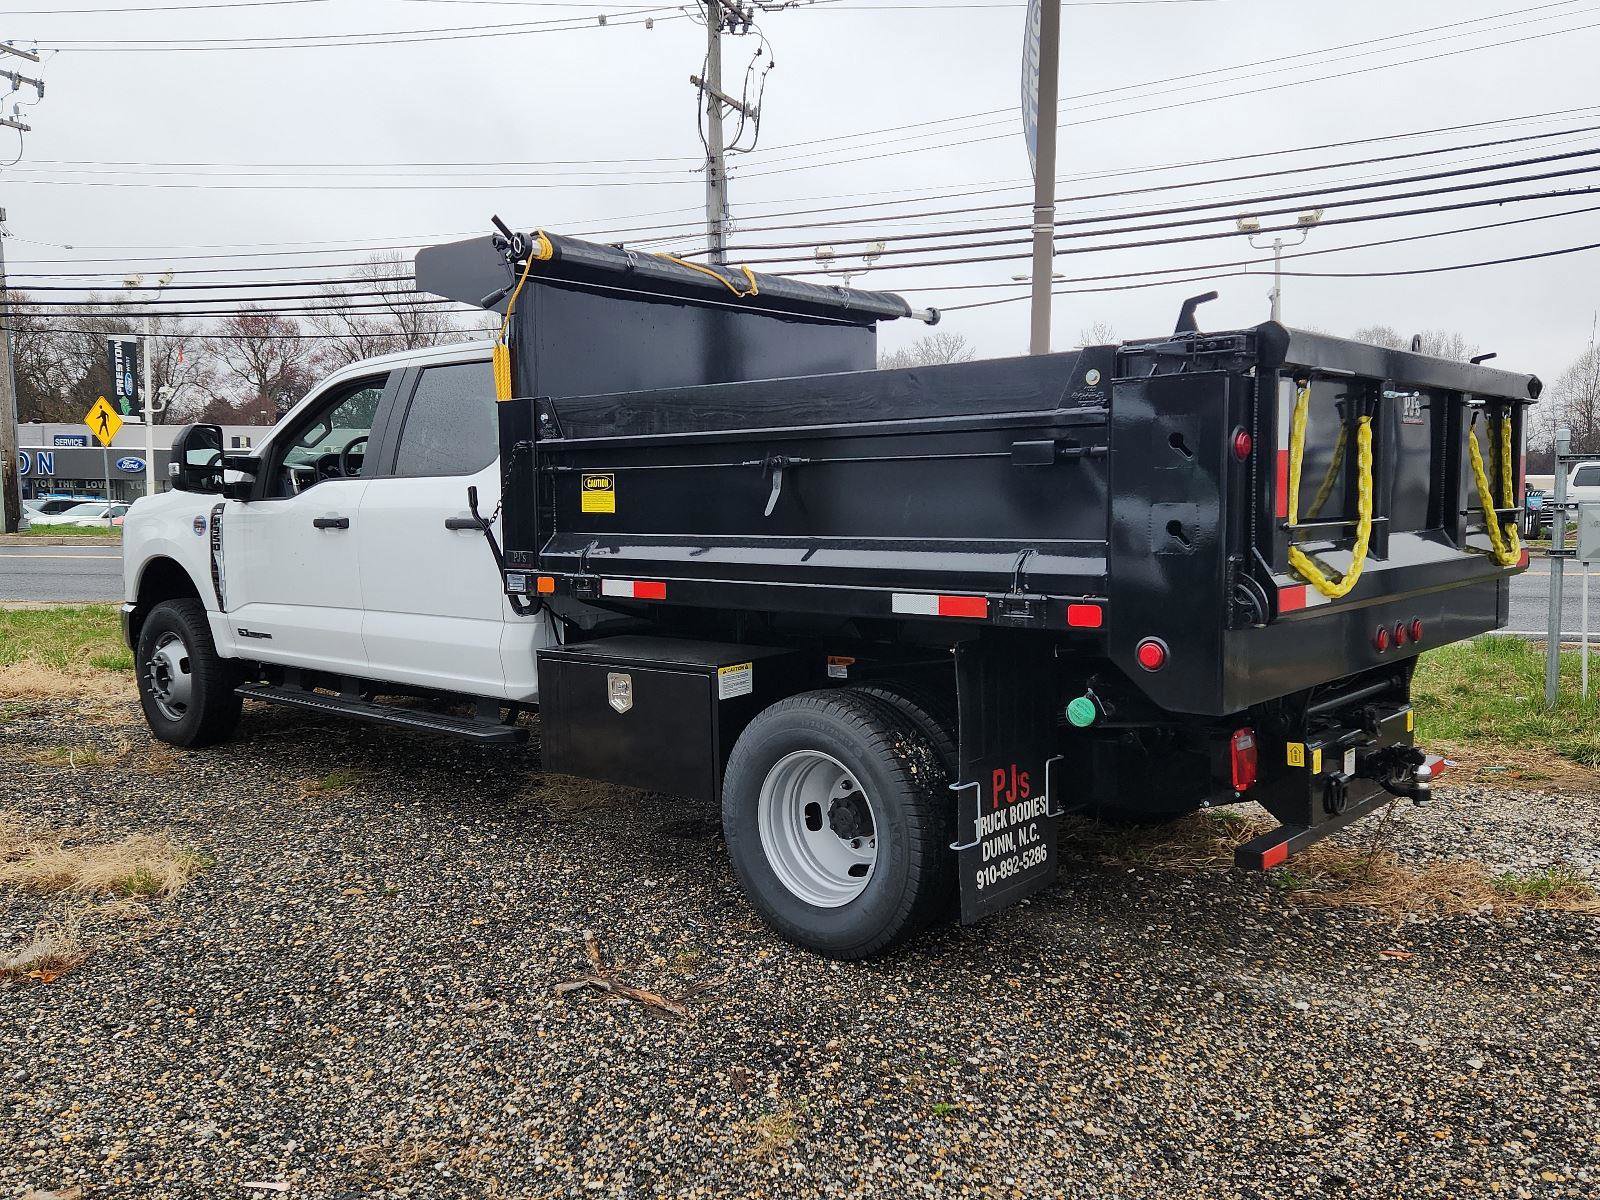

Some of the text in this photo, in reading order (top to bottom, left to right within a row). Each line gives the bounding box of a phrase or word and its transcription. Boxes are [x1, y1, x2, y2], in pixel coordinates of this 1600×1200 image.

[114, 340, 124, 395] PRESTON
[54, 438, 83, 446] SERVICE
[587, 478, 609, 488] CAUTION
[726, 664, 745, 673] CAUTION
[1010, 796, 1046, 825] BODIES
[982, 823, 1040, 862] DUNN, N.C.
[976, 844, 1047, 890] 910-892-5286
